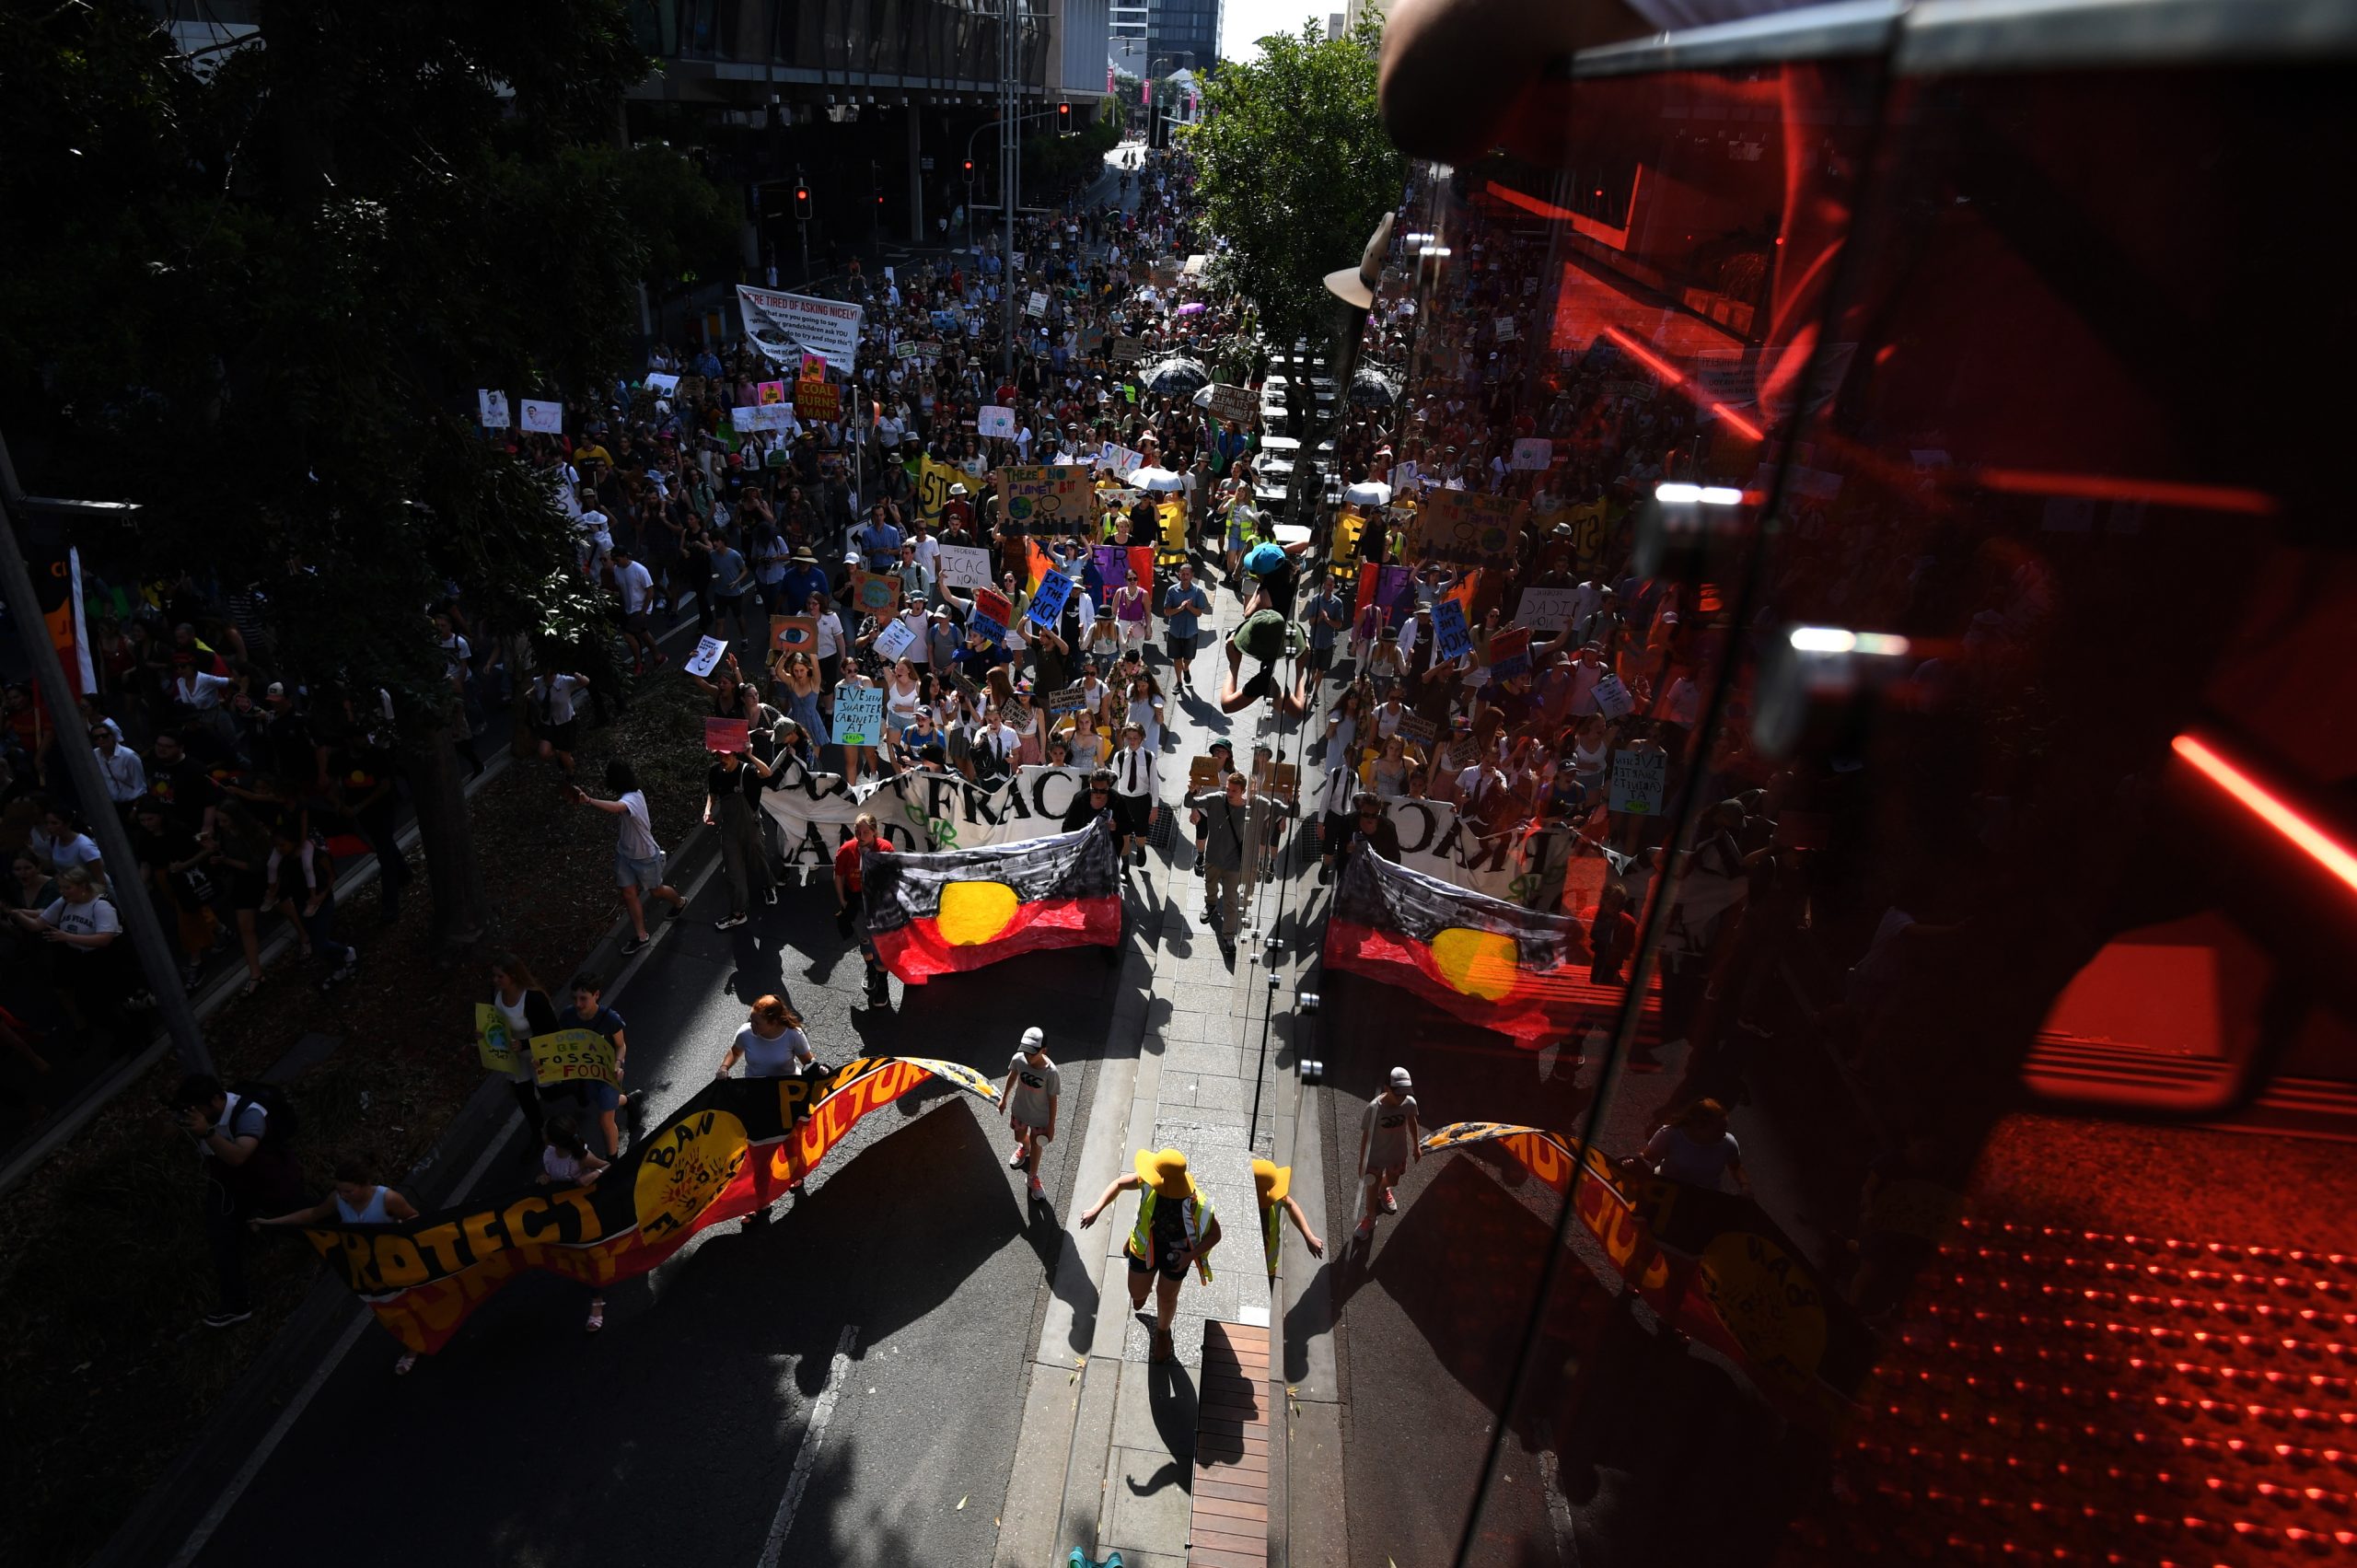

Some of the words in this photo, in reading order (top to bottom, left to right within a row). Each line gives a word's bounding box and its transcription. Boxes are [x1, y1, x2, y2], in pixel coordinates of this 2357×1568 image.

[766, 296, 787, 308] TIRED
[789, 299, 798, 309] OF
[801, 302, 829, 316] ASKING
[830, 306, 857, 320] NICELY!
[790, 315, 801, 323] you
[802, 317, 819, 325] going
[783, 320, 824, 332] grandchildren
[836, 330, 848, 338] YOU
[824, 337, 836, 345] stop
[802, 383, 834, 396] COAL
[1215, 385, 1232, 397] KEEP
[1234, 388, 1246, 400] THE
[797, 395, 837, 408] BURNS
[1210, 402, 1223, 412] NOT
[1213, 394, 1234, 407] CLEAN
[803, 406, 834, 421] MAN!
[1101, 444, 1142, 470] SAVE
[1048, 468, 1066, 480] NO
[1008, 480, 1054, 498] PLANET
[946, 556, 985, 575] ICAC
[958, 575, 979, 585] NOW
[1046, 587, 1063, 601] THE
[1029, 598, 1060, 624] RICH
[837, 686, 865, 702] I'VE
[1062, 687, 1085, 695] CLIMATE
[1057, 694, 1085, 703] CHANGING
[840, 703, 881, 714] SMARTER
[835, 713, 879, 724] CABINETS
[847, 723, 863, 732] AT
[557, 1042, 578, 1053] BE
[563, 1064, 611, 1083] FOOL
[645, 1111, 715, 1169] BAN
[302, 1184, 603, 1293] PROTECT
